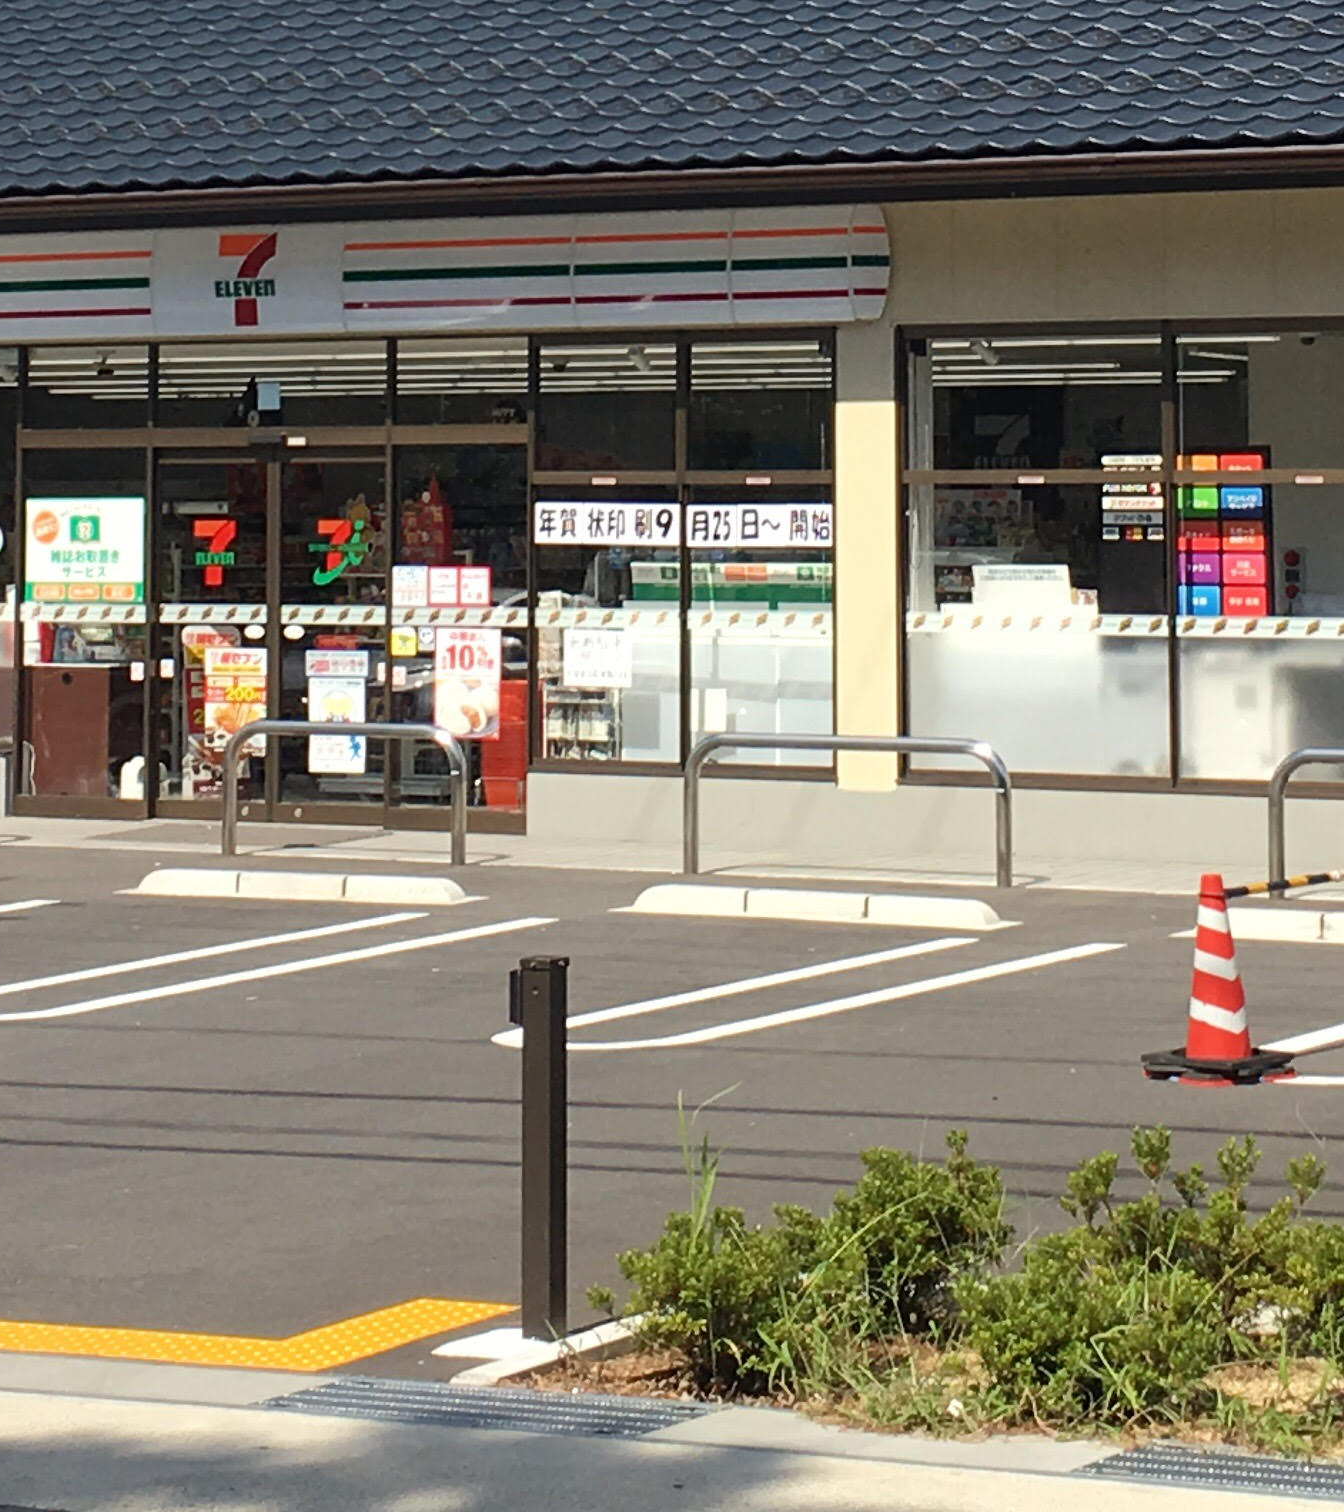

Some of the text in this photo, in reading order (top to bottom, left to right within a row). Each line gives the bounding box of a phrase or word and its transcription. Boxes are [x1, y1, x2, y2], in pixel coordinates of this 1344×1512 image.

[218, 232, 277, 327] 7
[62, 566, 106, 579] サービス
